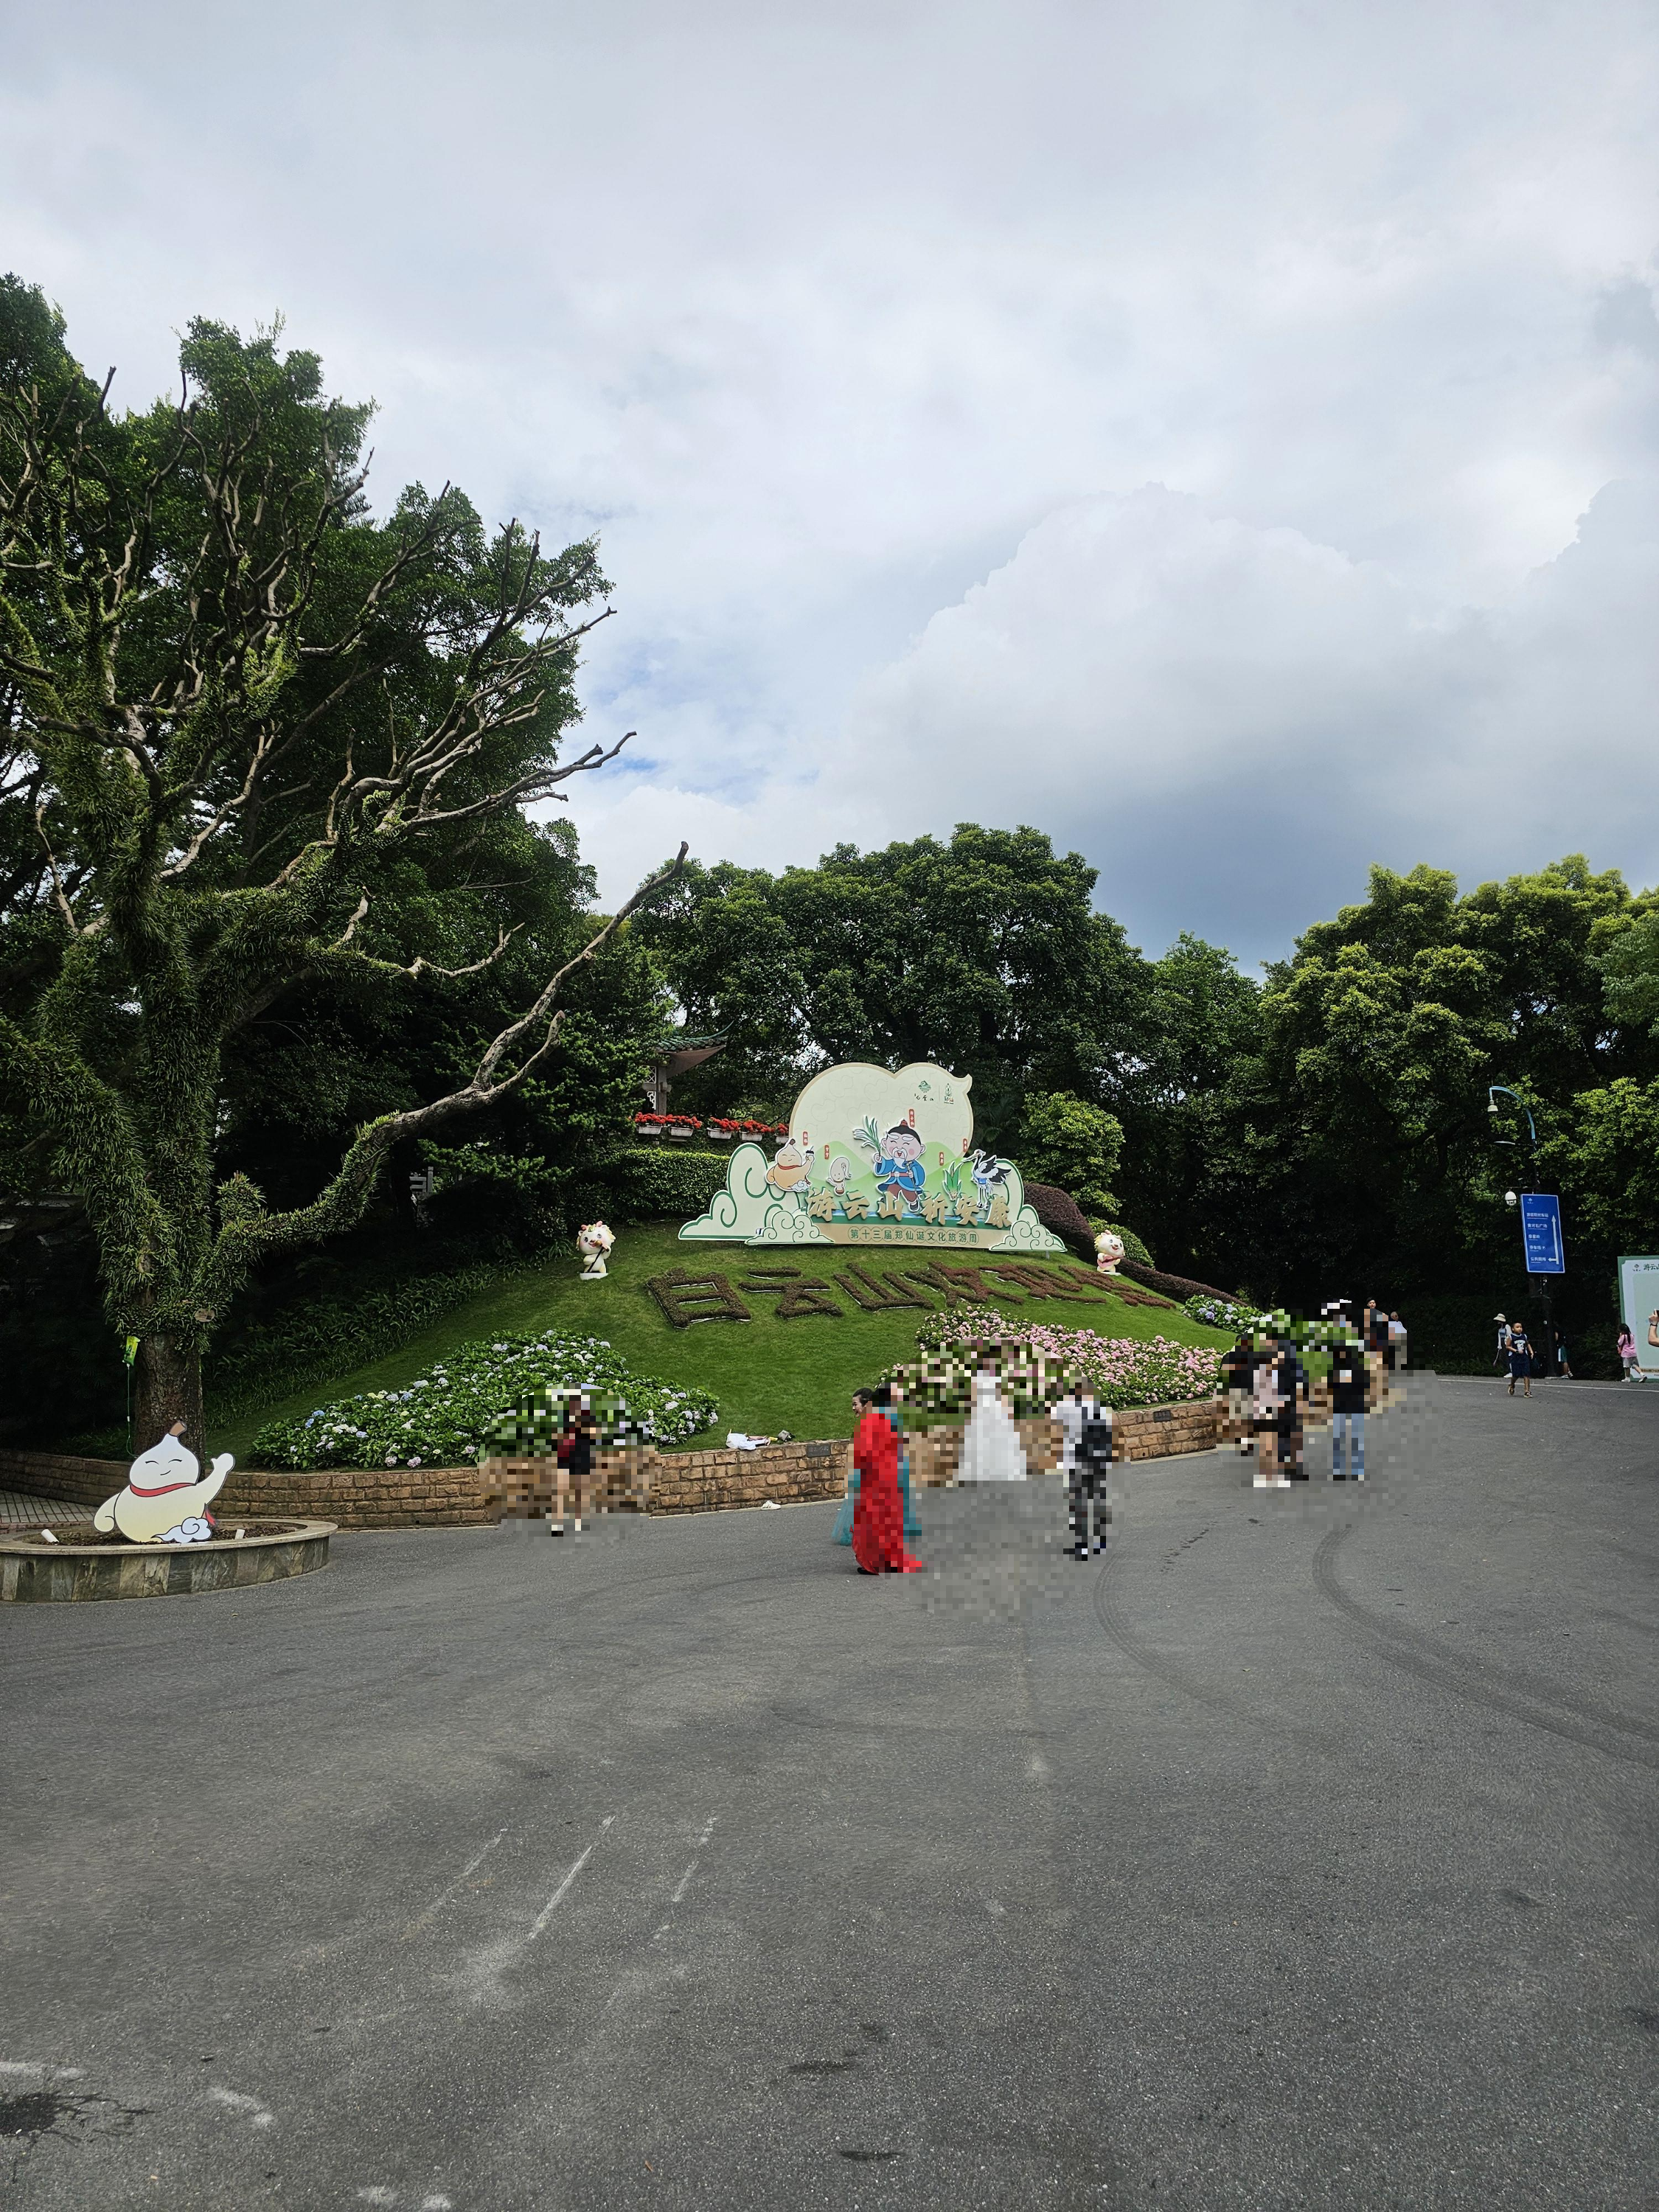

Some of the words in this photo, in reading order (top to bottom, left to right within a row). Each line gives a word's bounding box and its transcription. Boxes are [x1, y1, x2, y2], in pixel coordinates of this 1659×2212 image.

[850, 1229, 977, 1243] 第十三届郑仙诞文化旅游周
[645, 1261, 1178, 1329] 白云山欢迎您
